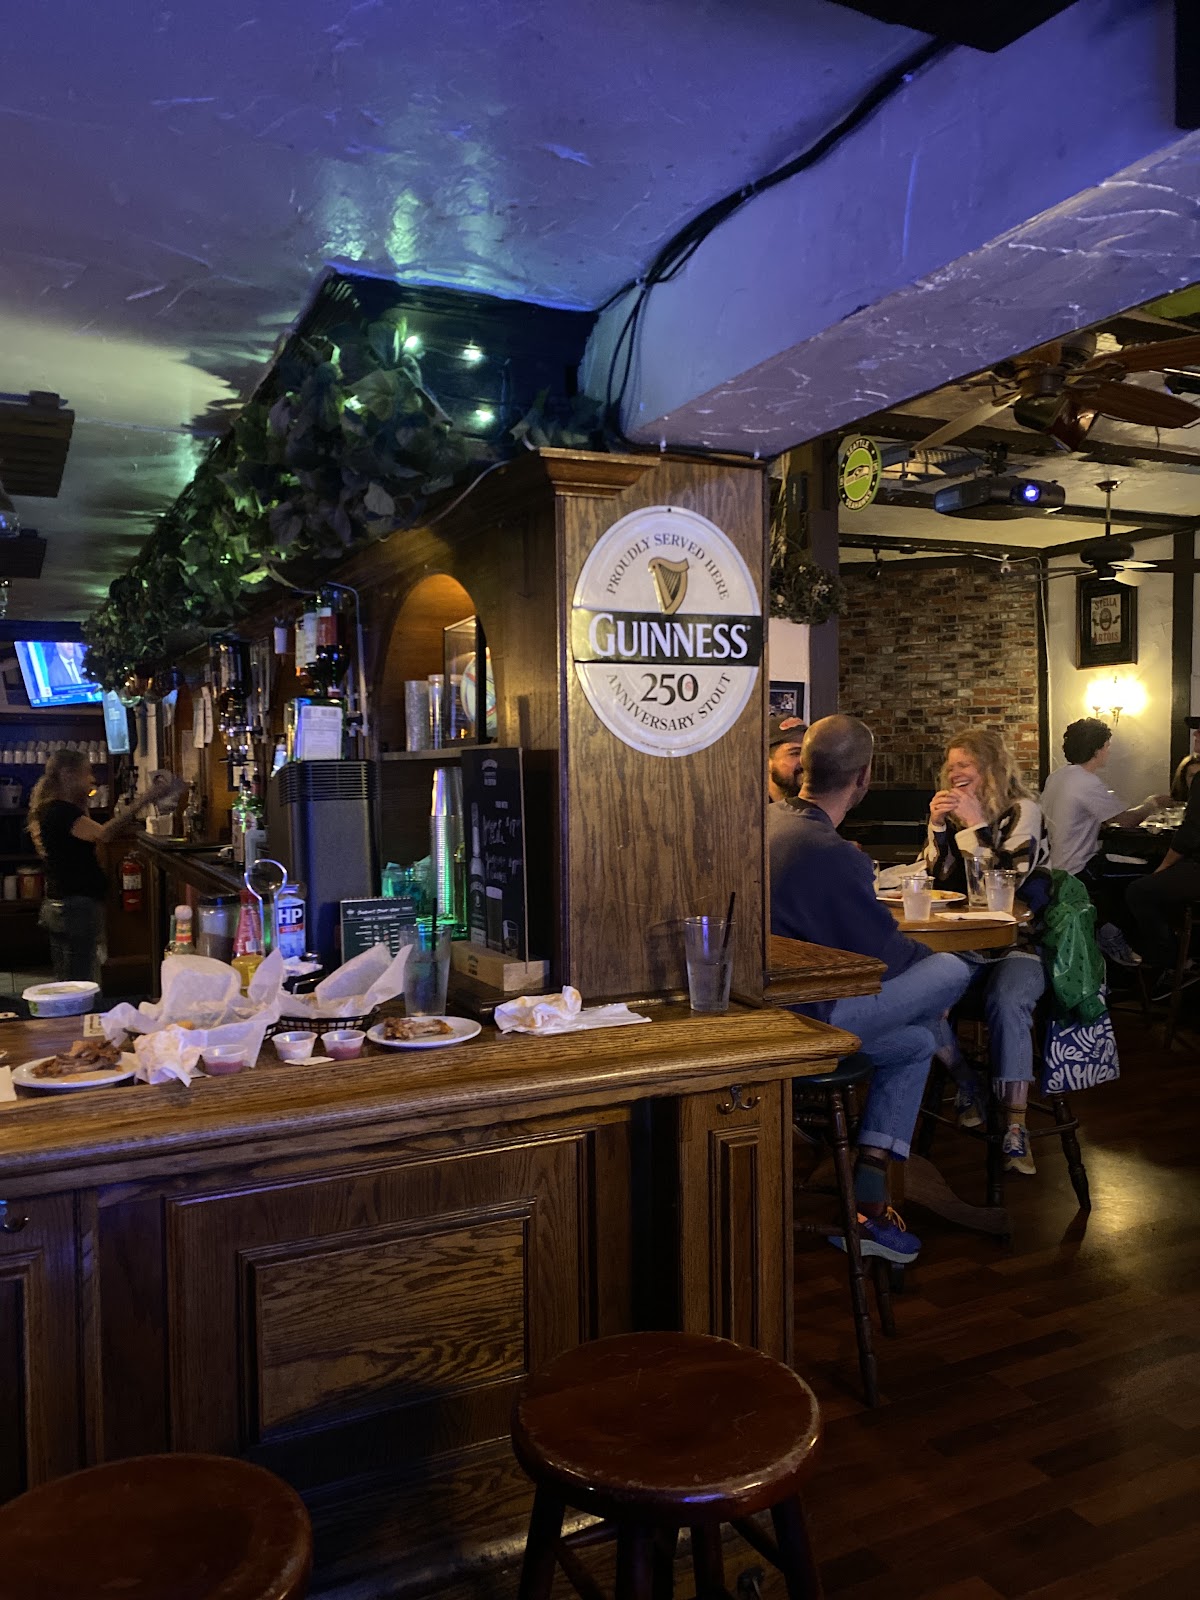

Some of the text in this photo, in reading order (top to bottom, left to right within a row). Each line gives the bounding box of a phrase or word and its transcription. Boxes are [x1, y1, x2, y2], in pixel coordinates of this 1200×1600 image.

[846, 439, 870, 457] SEATTLE
[606, 533, 730, 600] PROUDLY SERVED HERE
[1094, 597, 1117, 610] STELLA
[588, 613, 748, 660] GUINNESS
[606, 672, 732, 732] ANNIVERSARY STOUT
[640, 673, 699, 706] 250
[278, 908, 303, 924] HP
